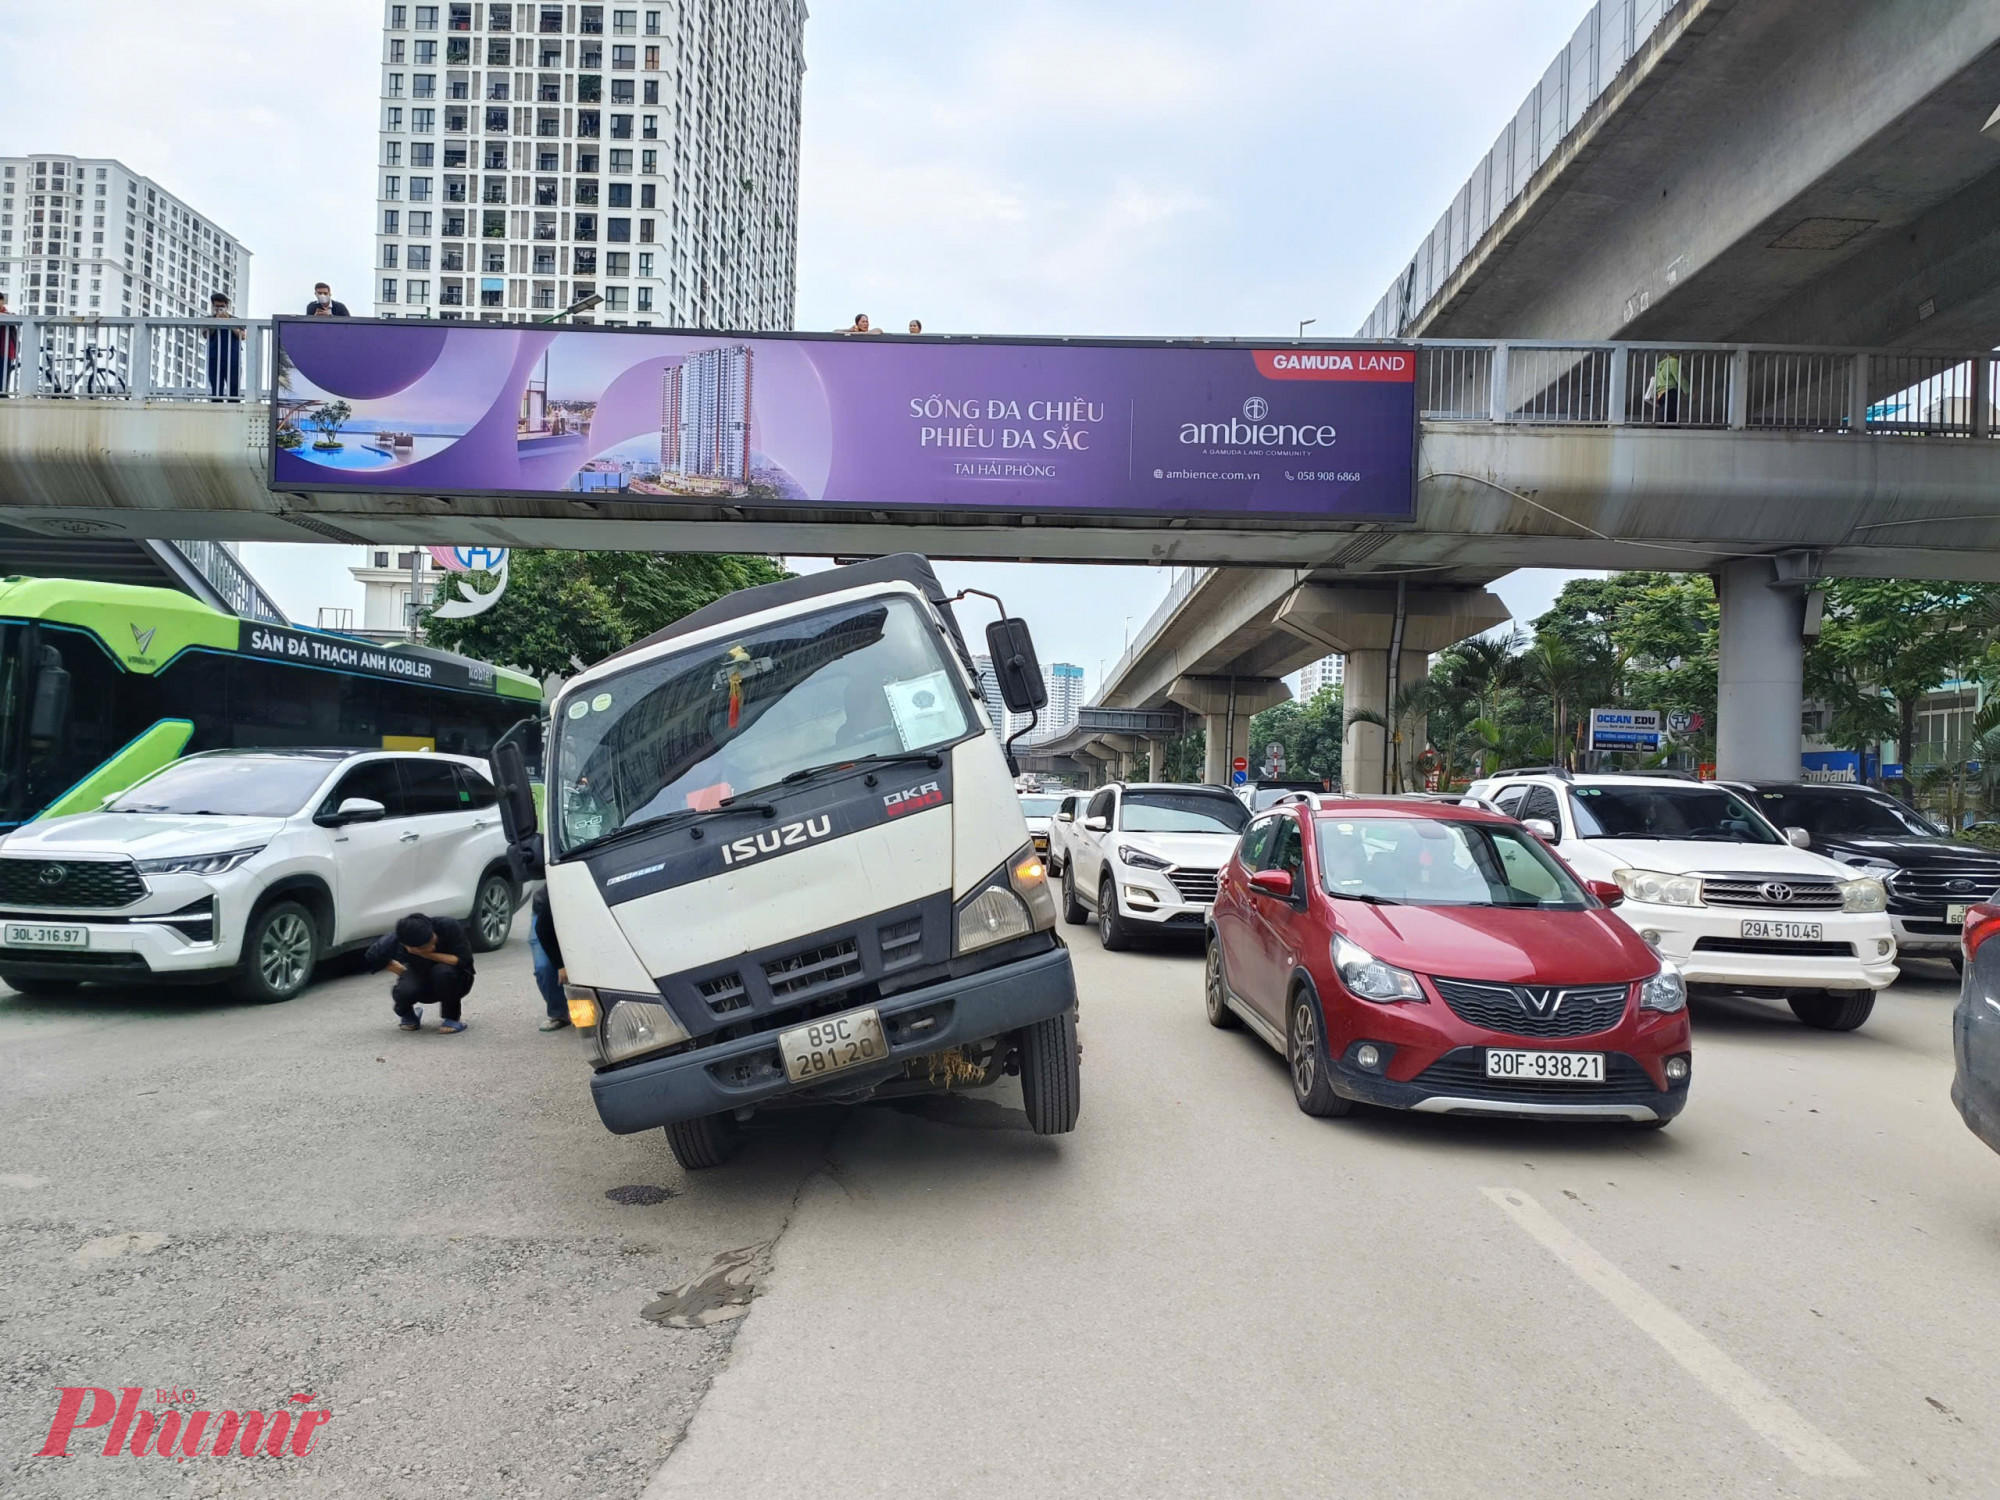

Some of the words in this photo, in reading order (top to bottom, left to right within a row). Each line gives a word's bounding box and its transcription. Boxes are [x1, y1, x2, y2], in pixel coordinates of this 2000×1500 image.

[1273, 355, 1354, 370] GAMUDA
[1358, 356, 1405, 371] LAND
[909, 393, 980, 419] SỐNG
[986, 400, 1022, 420] ĐA
[1027, 396, 1104, 422] CHIỀU
[920, 423, 995, 448] PHIÊU
[1001, 428, 1036, 449] ĐA
[1042, 423, 1090, 451] SẮC
[1179, 417, 1336, 447] ambience
[954, 463, 974, 478] TẠI
[978, 460, 1001, 476] HẢI
[1004, 462, 1056, 477] PHÒNG
[1166, 469, 1260, 480] ambience.com.vn
[1297, 471, 1315, 480] 058
[1317, 471, 1335, 481] 908
[1336, 472, 1360, 482] 6868
[251, 629, 284, 653] SÀN
[287, 636, 309, 658] ĐÁ
[312, 642, 357, 666] THẠCH
[360, 652, 386, 670] ANH
[388, 657, 432, 679] KOBLER
[1597, 714, 1632, 724] OCEAN
[1634, 716, 1656, 725] EDU
[883, 781, 941, 806] QKR
[721, 814, 832, 865] ISUZU
[12, 928, 80, 942] 30L-316.97
[1744, 922, 1820, 939] 29A-510.45
[807, 1019, 851, 1048] 89C
[796, 1037, 874, 1076] 281.20
[1490, 1053, 1599, 1079] 30F-938.21
